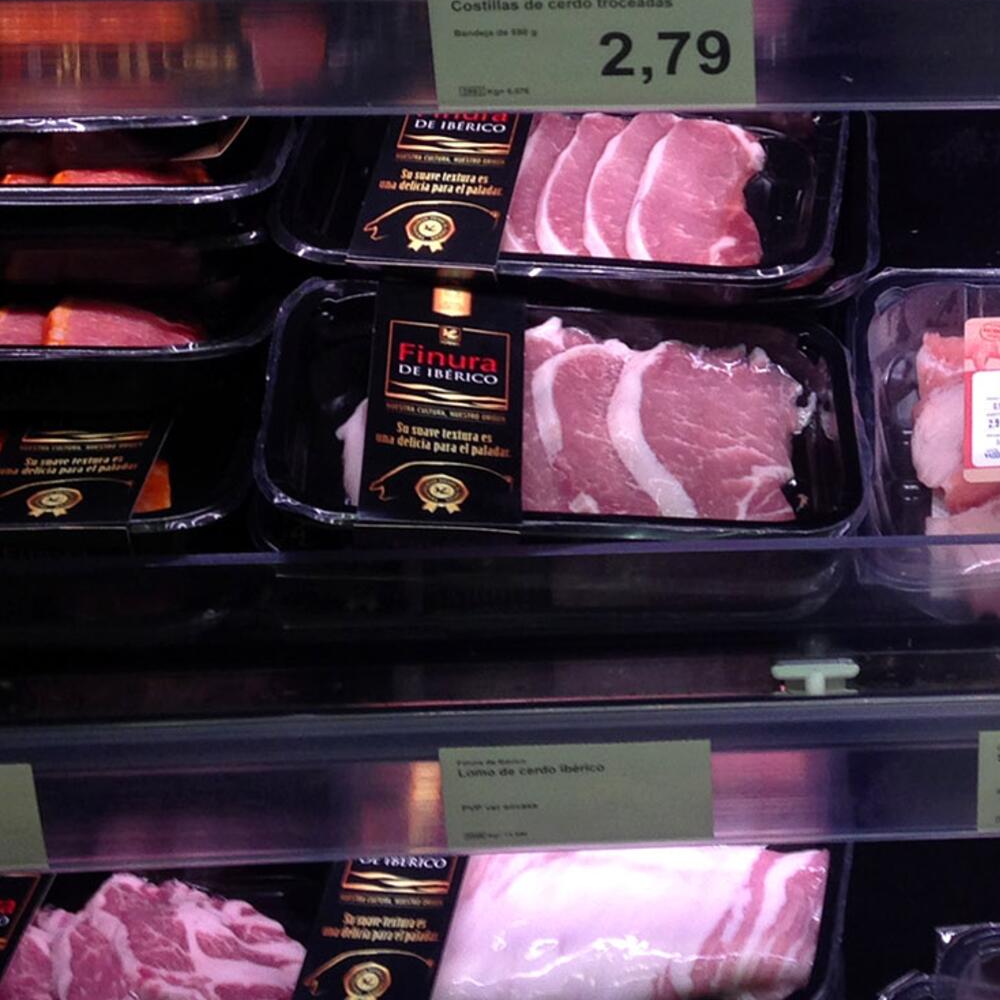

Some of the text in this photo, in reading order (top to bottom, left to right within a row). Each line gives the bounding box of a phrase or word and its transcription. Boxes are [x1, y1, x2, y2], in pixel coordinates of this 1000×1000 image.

[451, 0, 519, 12] Costillas
[524, 0, 543, 11] de
[454, 29, 494, 39] Bandeja
[496, 29, 508, 37] de
[529, 30, 538, 39] g
[599, 30, 731, 84] 2,79
[414, 119, 507, 133] DE IBÉRICO
[400, 168, 488, 184] Su suave textura es
[379, 180, 397, 190] una
[399, 180, 430, 192] delicia
[431, 183, 453, 196] para
[455, 182, 465, 194] el
[398, 342, 498, 373] Finura
[398, 364, 498, 386] DE IBÉRICO
[396, 422, 493, 443] Su suave textura es
[375, 432, 395, 445] una
[397, 433, 431, 450] delicia
[433, 438, 457, 453] para
[459, 440, 469, 454] el
[458, 763, 605, 778] Lomo de cerdo ibérico
